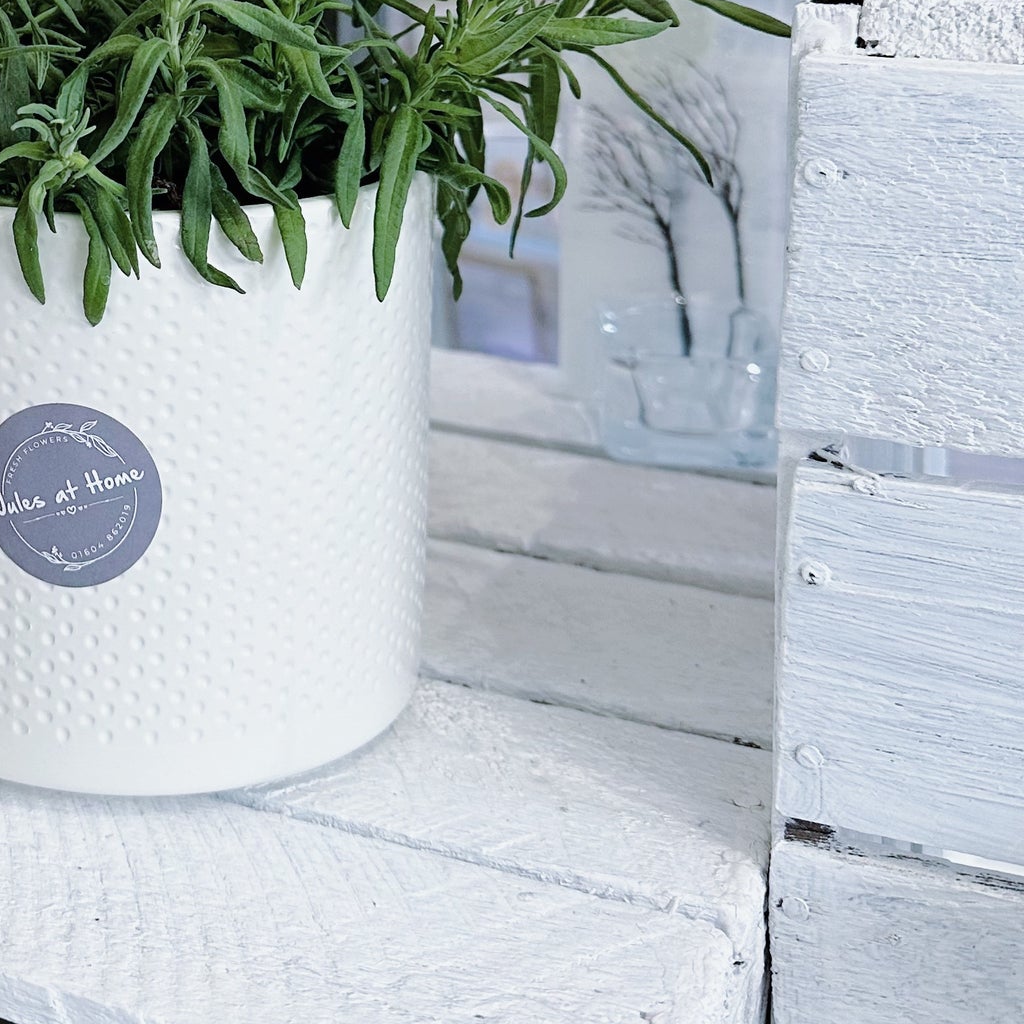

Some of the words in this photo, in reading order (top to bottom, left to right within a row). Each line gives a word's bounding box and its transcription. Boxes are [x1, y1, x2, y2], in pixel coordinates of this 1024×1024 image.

[6, 454, 23, 485] FRESH
[23, 436, 69, 455] FLOWERS
[55, 479, 79, 504] at
[84, 469, 145, 495] Home
[71, 542, 104, 559] 01604
[106, 504, 131, 542] 862019
